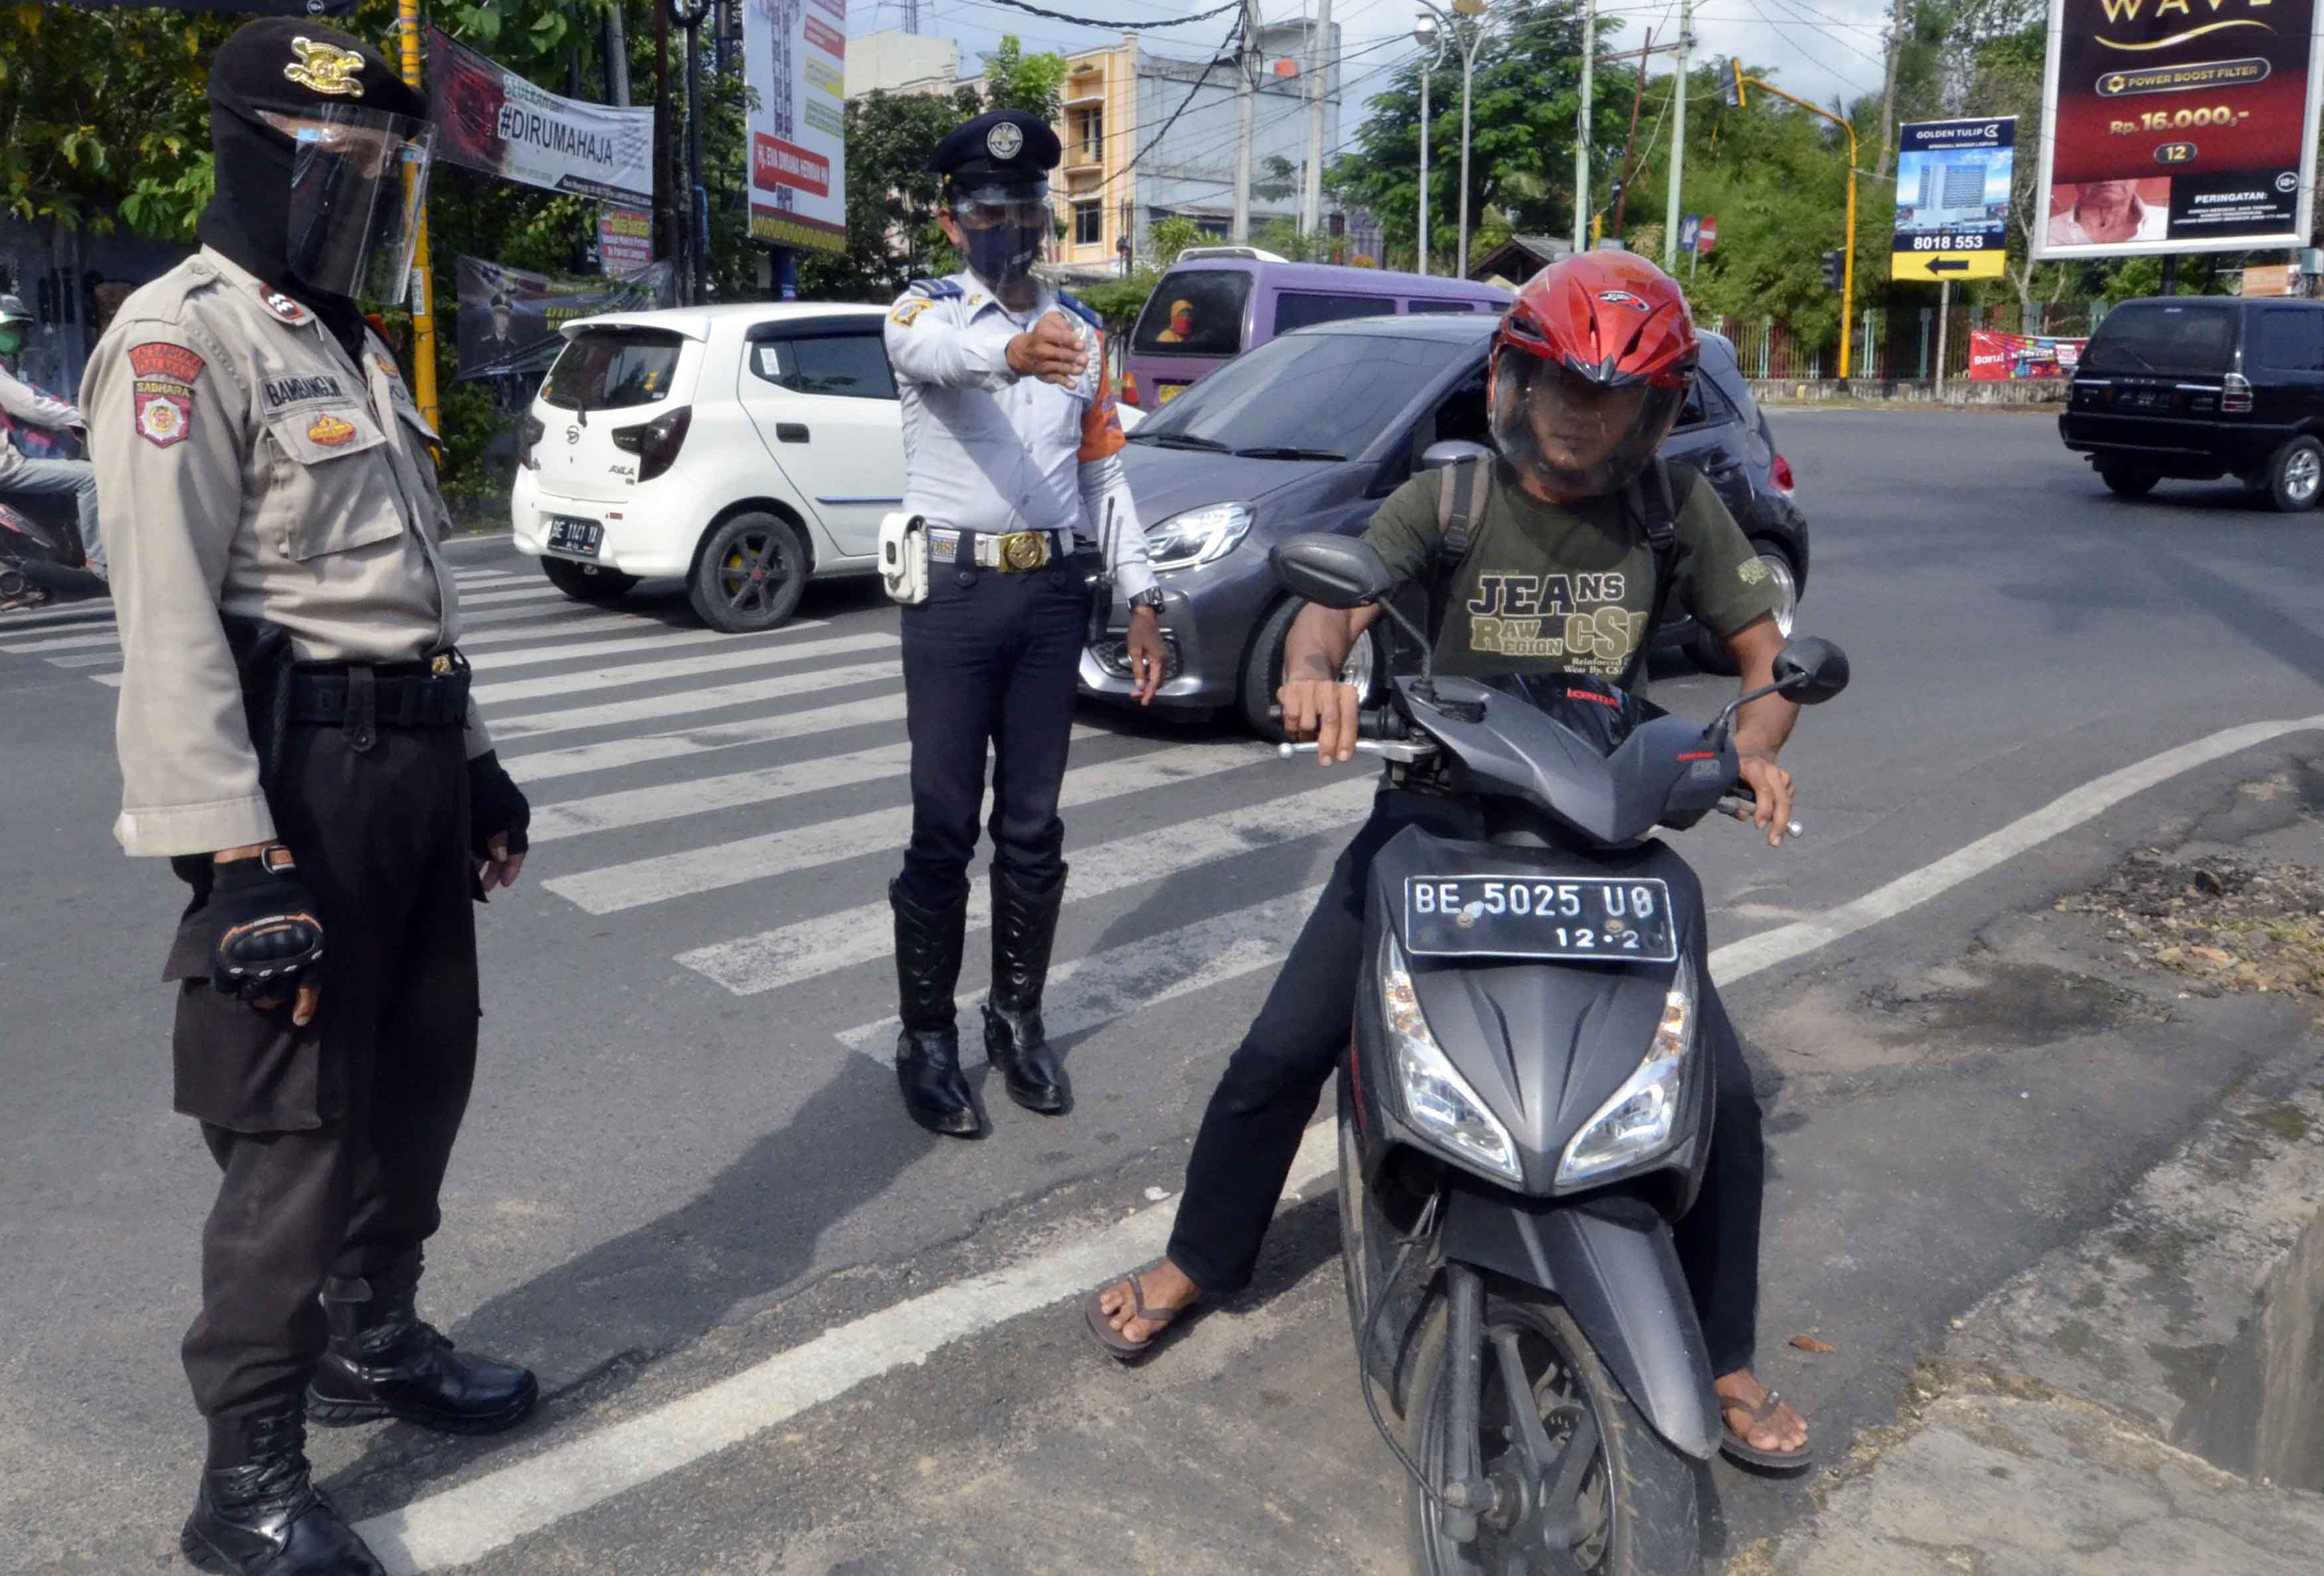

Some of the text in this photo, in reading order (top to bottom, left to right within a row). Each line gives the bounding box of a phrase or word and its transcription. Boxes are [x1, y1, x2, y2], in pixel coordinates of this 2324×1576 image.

[2128, 66, 2258, 87] POWER BOOST FILTER
[499, 104, 613, 166] #DIRUMAHAJA
[1916, 128, 1983, 139] GOLDEN TULIP
[2110, 120, 2140, 135] Rp.
[2167, 145, 2187, 160] 12
[2195, 191, 2268, 204] PERINGATAN:
[1914, 235, 1983, 250] 8018 553
[1974, 352, 2005, 365] Baru!
[552, 520, 565, 539] BE
[1467, 572, 1625, 616] JEANS
[1563, 665, 1586, 673] Wear
[1415, 883, 1461, 914] BE
[1484, 883, 1582, 917] 5025
